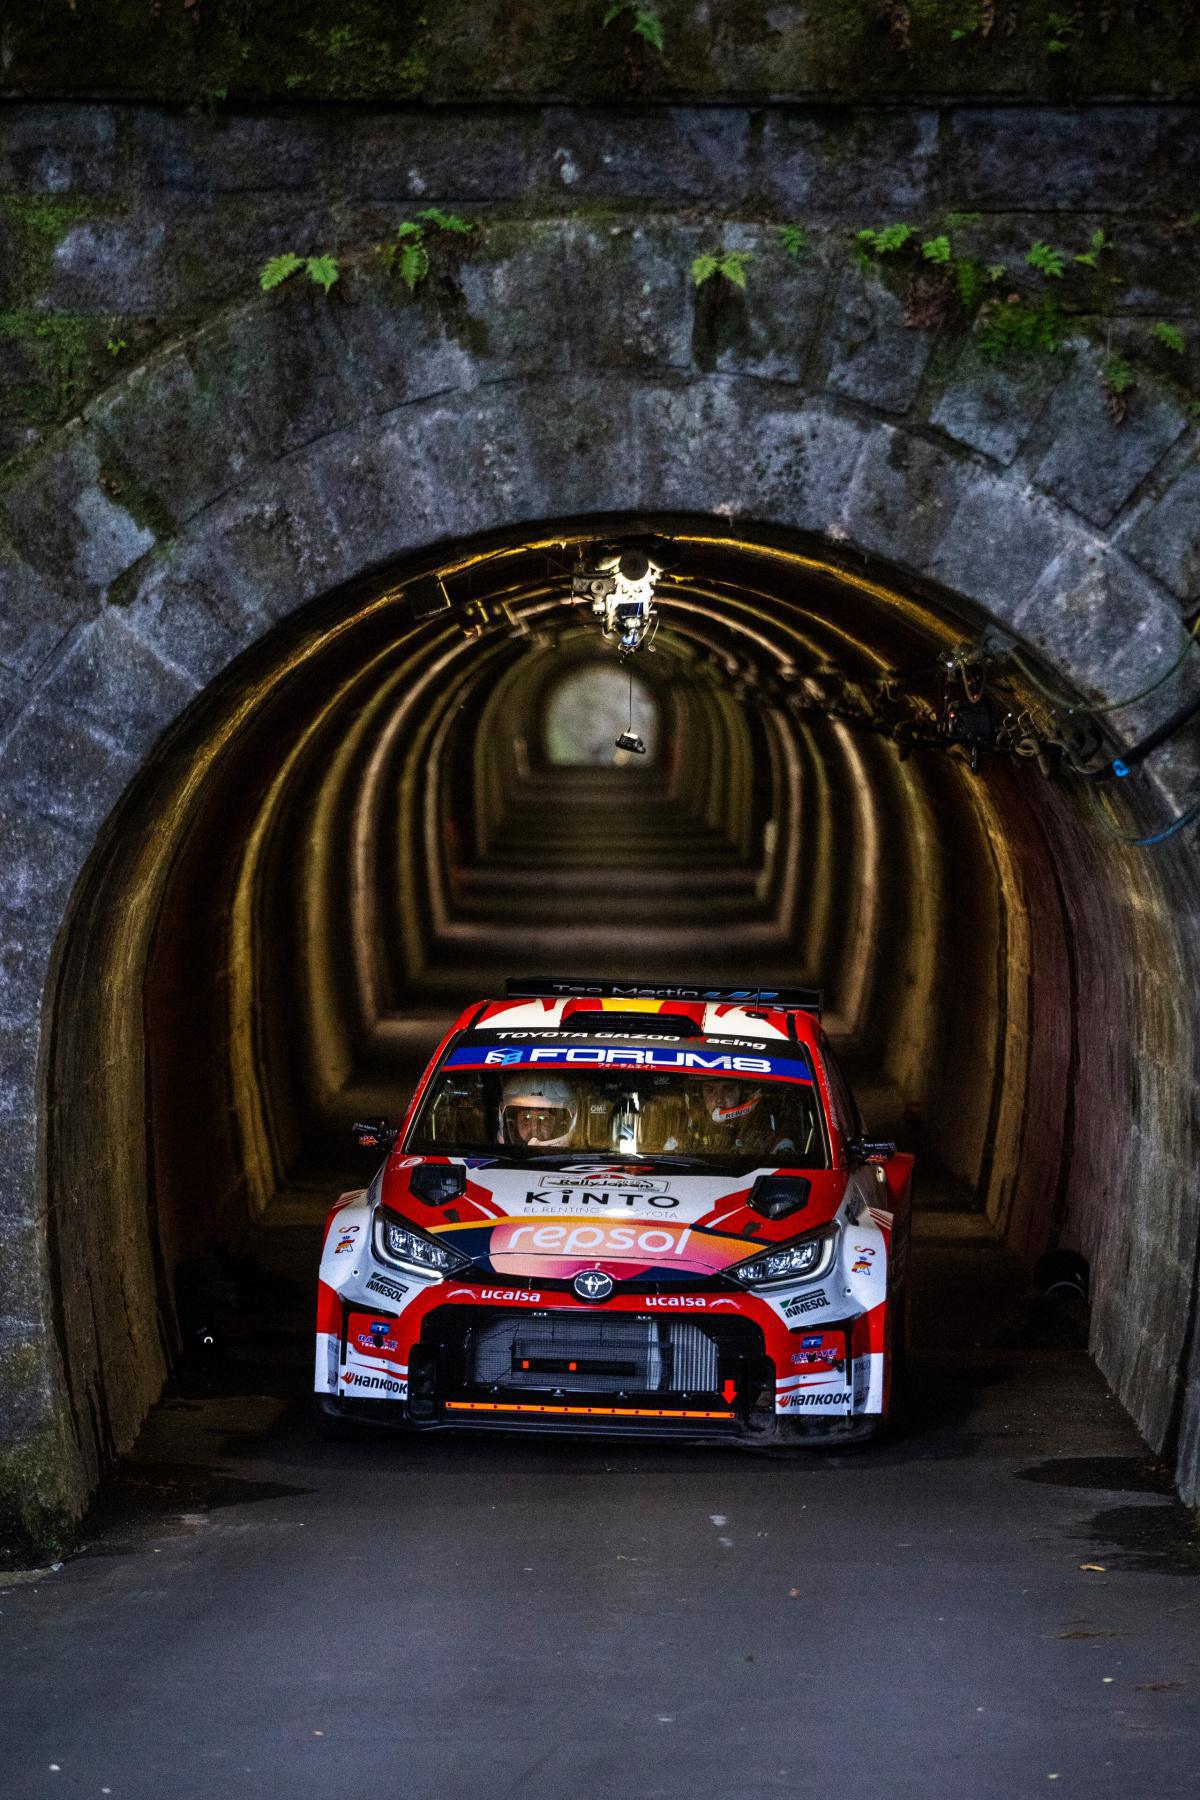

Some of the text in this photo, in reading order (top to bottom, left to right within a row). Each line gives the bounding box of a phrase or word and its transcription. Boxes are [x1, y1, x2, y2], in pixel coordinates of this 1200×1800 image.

[496, 1031, 589, 1039] TOYOTA
[594, 1032, 681, 1042] GAZOO
[528, 1048, 772, 1073] FORUM8
[507, 1226, 692, 1255] repsol
[481, 1288, 541, 1302] ucalsa
[645, 1294, 707, 1308] ucalsa
